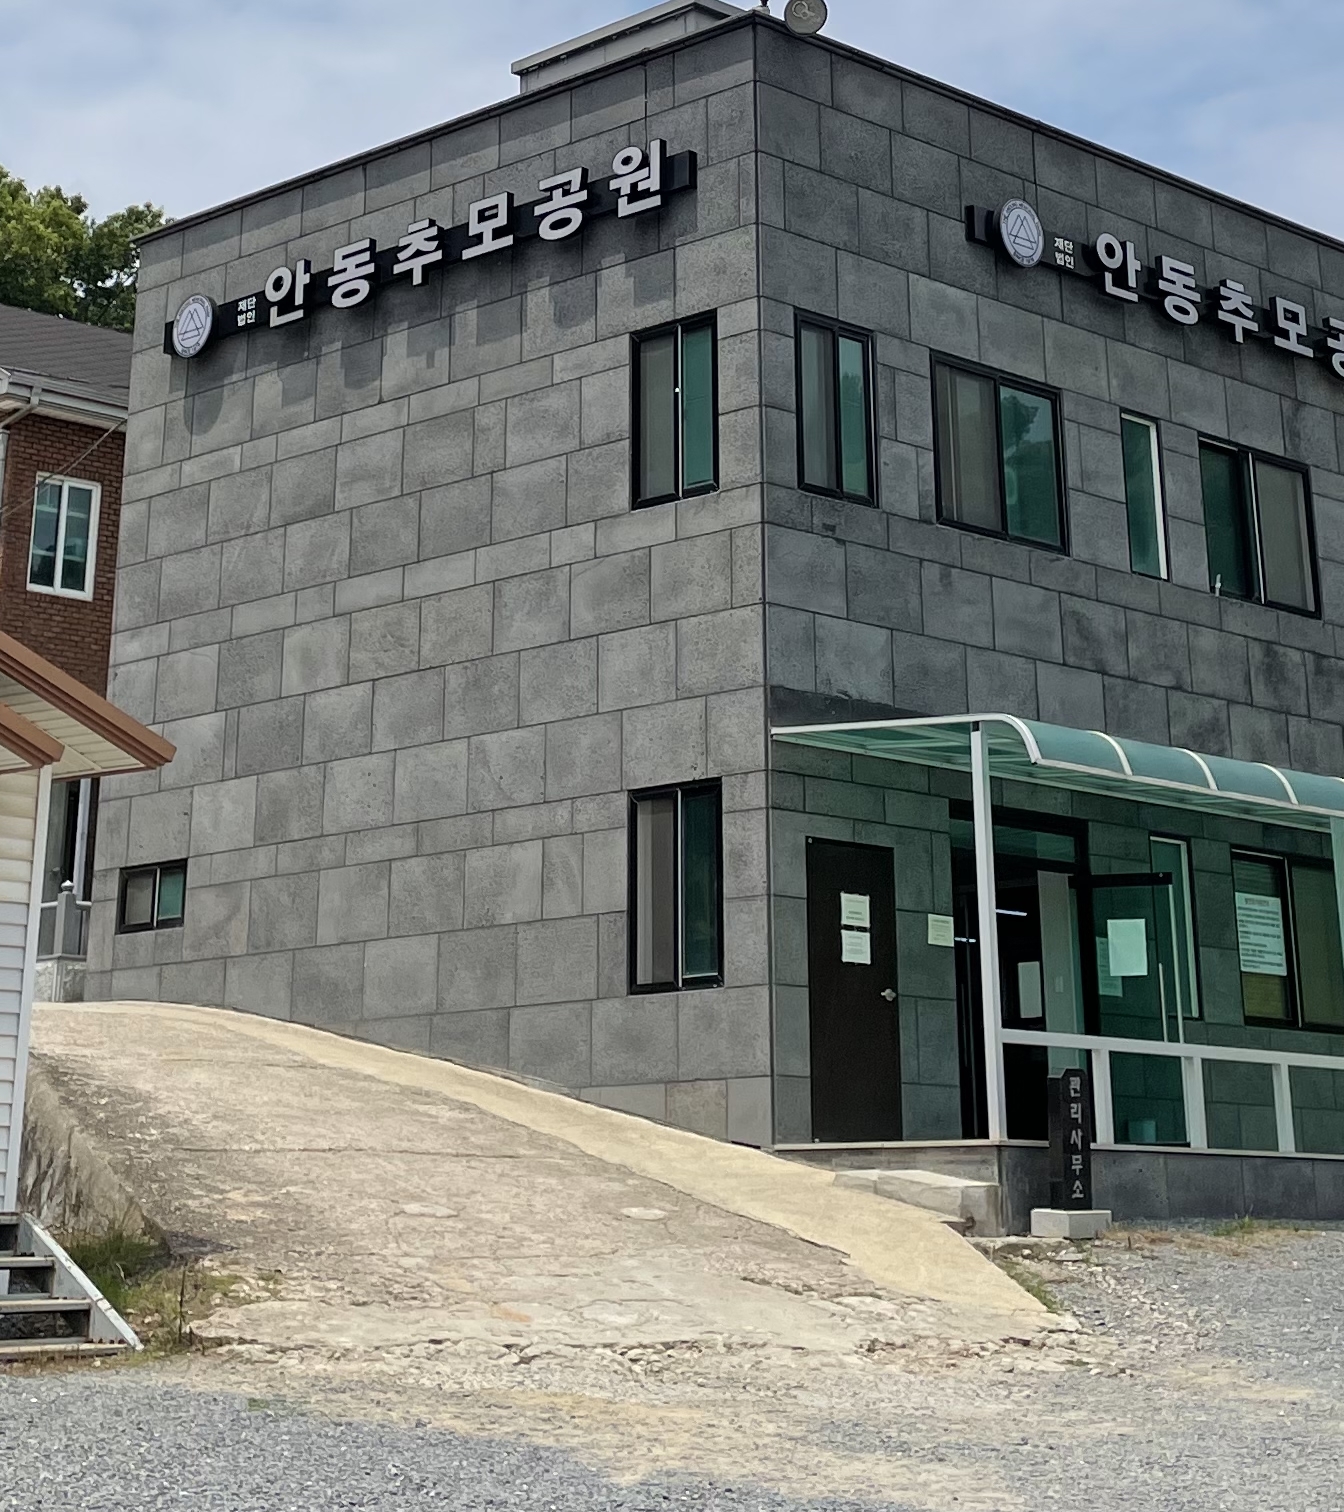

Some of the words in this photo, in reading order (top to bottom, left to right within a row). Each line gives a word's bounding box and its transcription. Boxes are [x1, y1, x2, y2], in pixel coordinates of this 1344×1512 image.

[264, 138, 662, 328] 안동추모공원
[1054, 236, 1074, 254] 재단
[1054, 251, 1075, 269] 법인
[237, 295, 257, 311] 재단
[237, 309, 256, 327] 법인
[1069, 1076, 1085, 1199] 관리사무소
